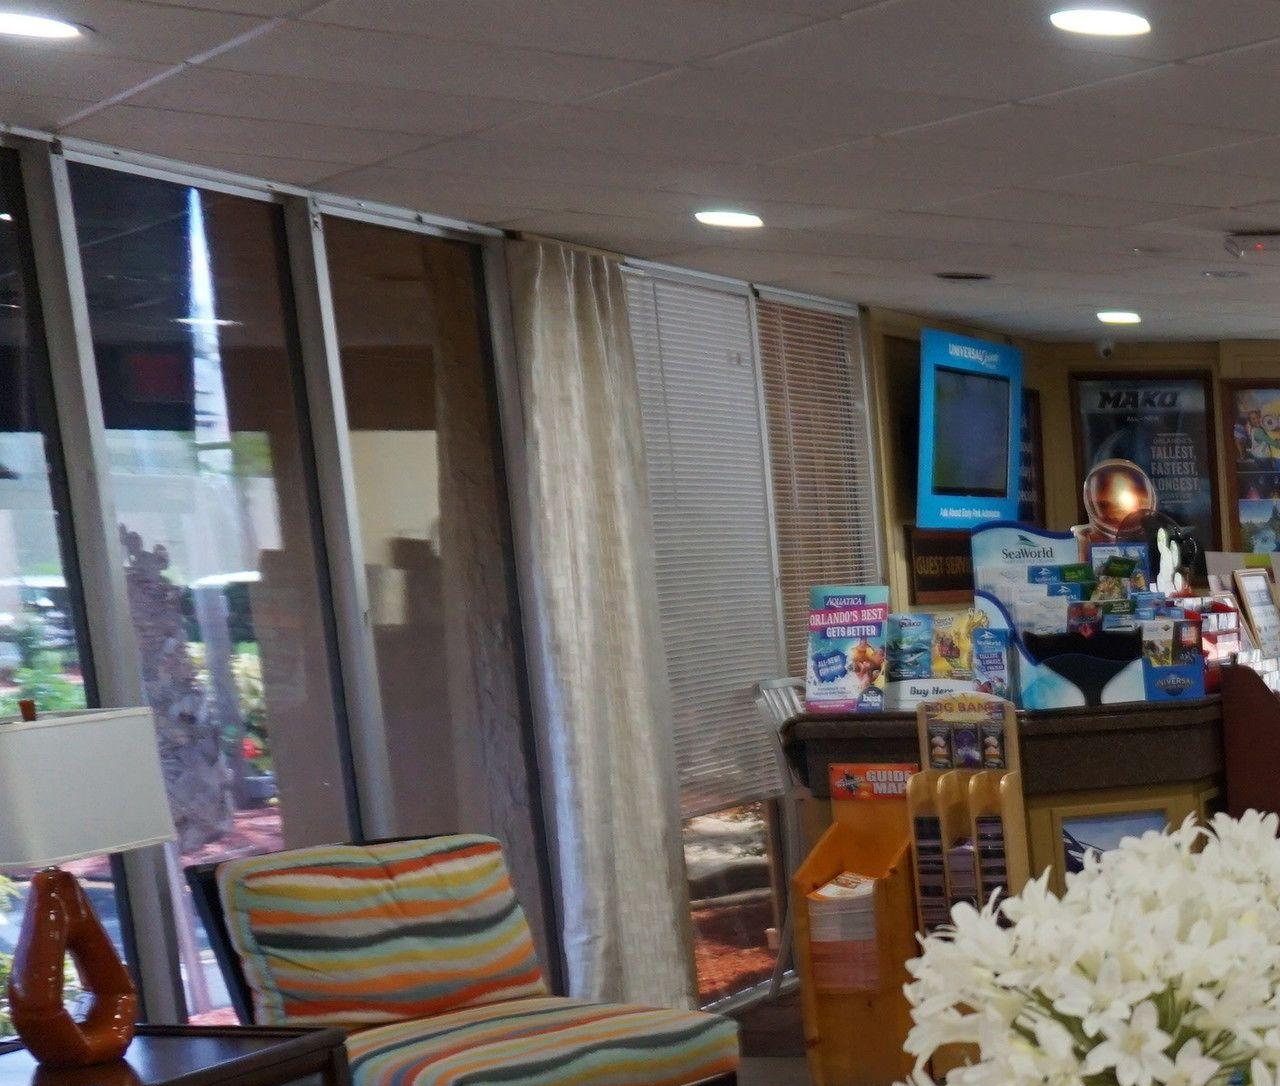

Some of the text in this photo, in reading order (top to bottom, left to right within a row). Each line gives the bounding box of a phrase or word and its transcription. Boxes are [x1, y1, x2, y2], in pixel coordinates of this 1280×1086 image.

[1098, 391, 1179, 409] MAKO
[1151, 446, 1197, 459] TALLEST,
[1151, 461, 1199, 475] FASTEST,
[1001, 547, 1054, 560] SeaWorld
[826, 597, 863, 608] AQUATICA
[809, 607, 884, 626] ORLANDO'S BEST
[826, 625, 876, 637] GETS BETTER
[909, 686, 954, 697] Buy Here
